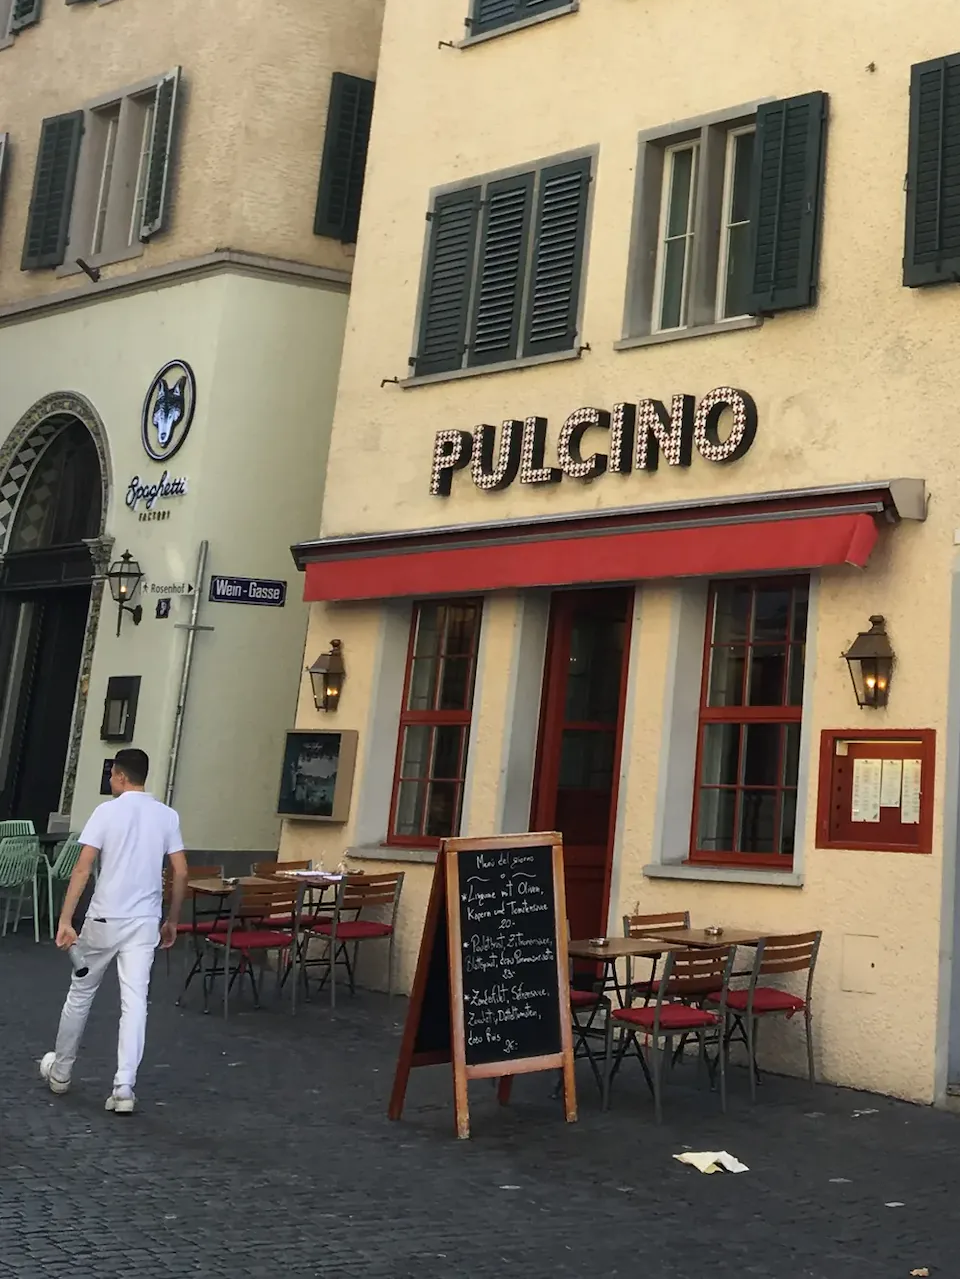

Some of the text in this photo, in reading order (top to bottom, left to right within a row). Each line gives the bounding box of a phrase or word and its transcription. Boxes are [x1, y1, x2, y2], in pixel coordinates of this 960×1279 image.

[429, 386, 759, 496] PULCINO
[125, 470, 188, 511] Spaghetti
[151, 582, 185, 594] Rosenhof
[494, 901, 505, 915] und
